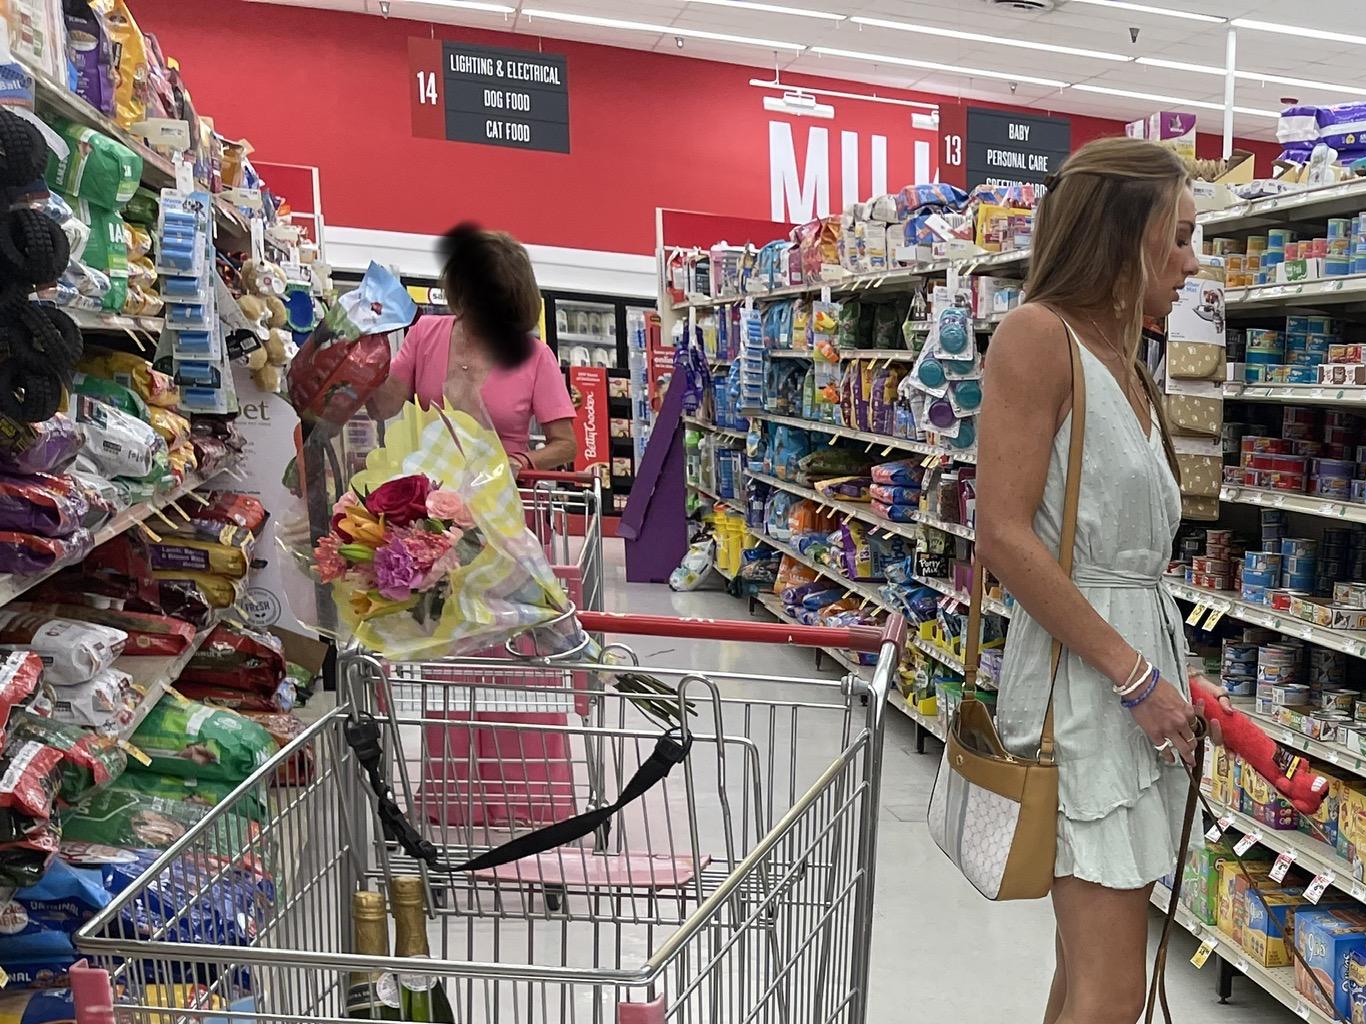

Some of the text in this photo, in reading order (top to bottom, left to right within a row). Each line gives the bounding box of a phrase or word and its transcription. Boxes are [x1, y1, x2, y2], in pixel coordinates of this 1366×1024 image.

[450, 54, 560, 85] LIGHTING & ELECTRICAL
[417, 71, 437, 105] 14
[484, 89, 530, 111] DOG FOOD
[486, 120, 530, 142] CAT FOOD
[1009, 123, 1030, 141] BABY
[944, 135, 961, 166] 13
[987, 149, 1049, 172] PERSONAL CARE
[769, 121, 939, 224] MI
[583, 391, 595, 427] Crocker
[585, 425, 597, 460] Betty
[919, 559, 941, 569] Party
